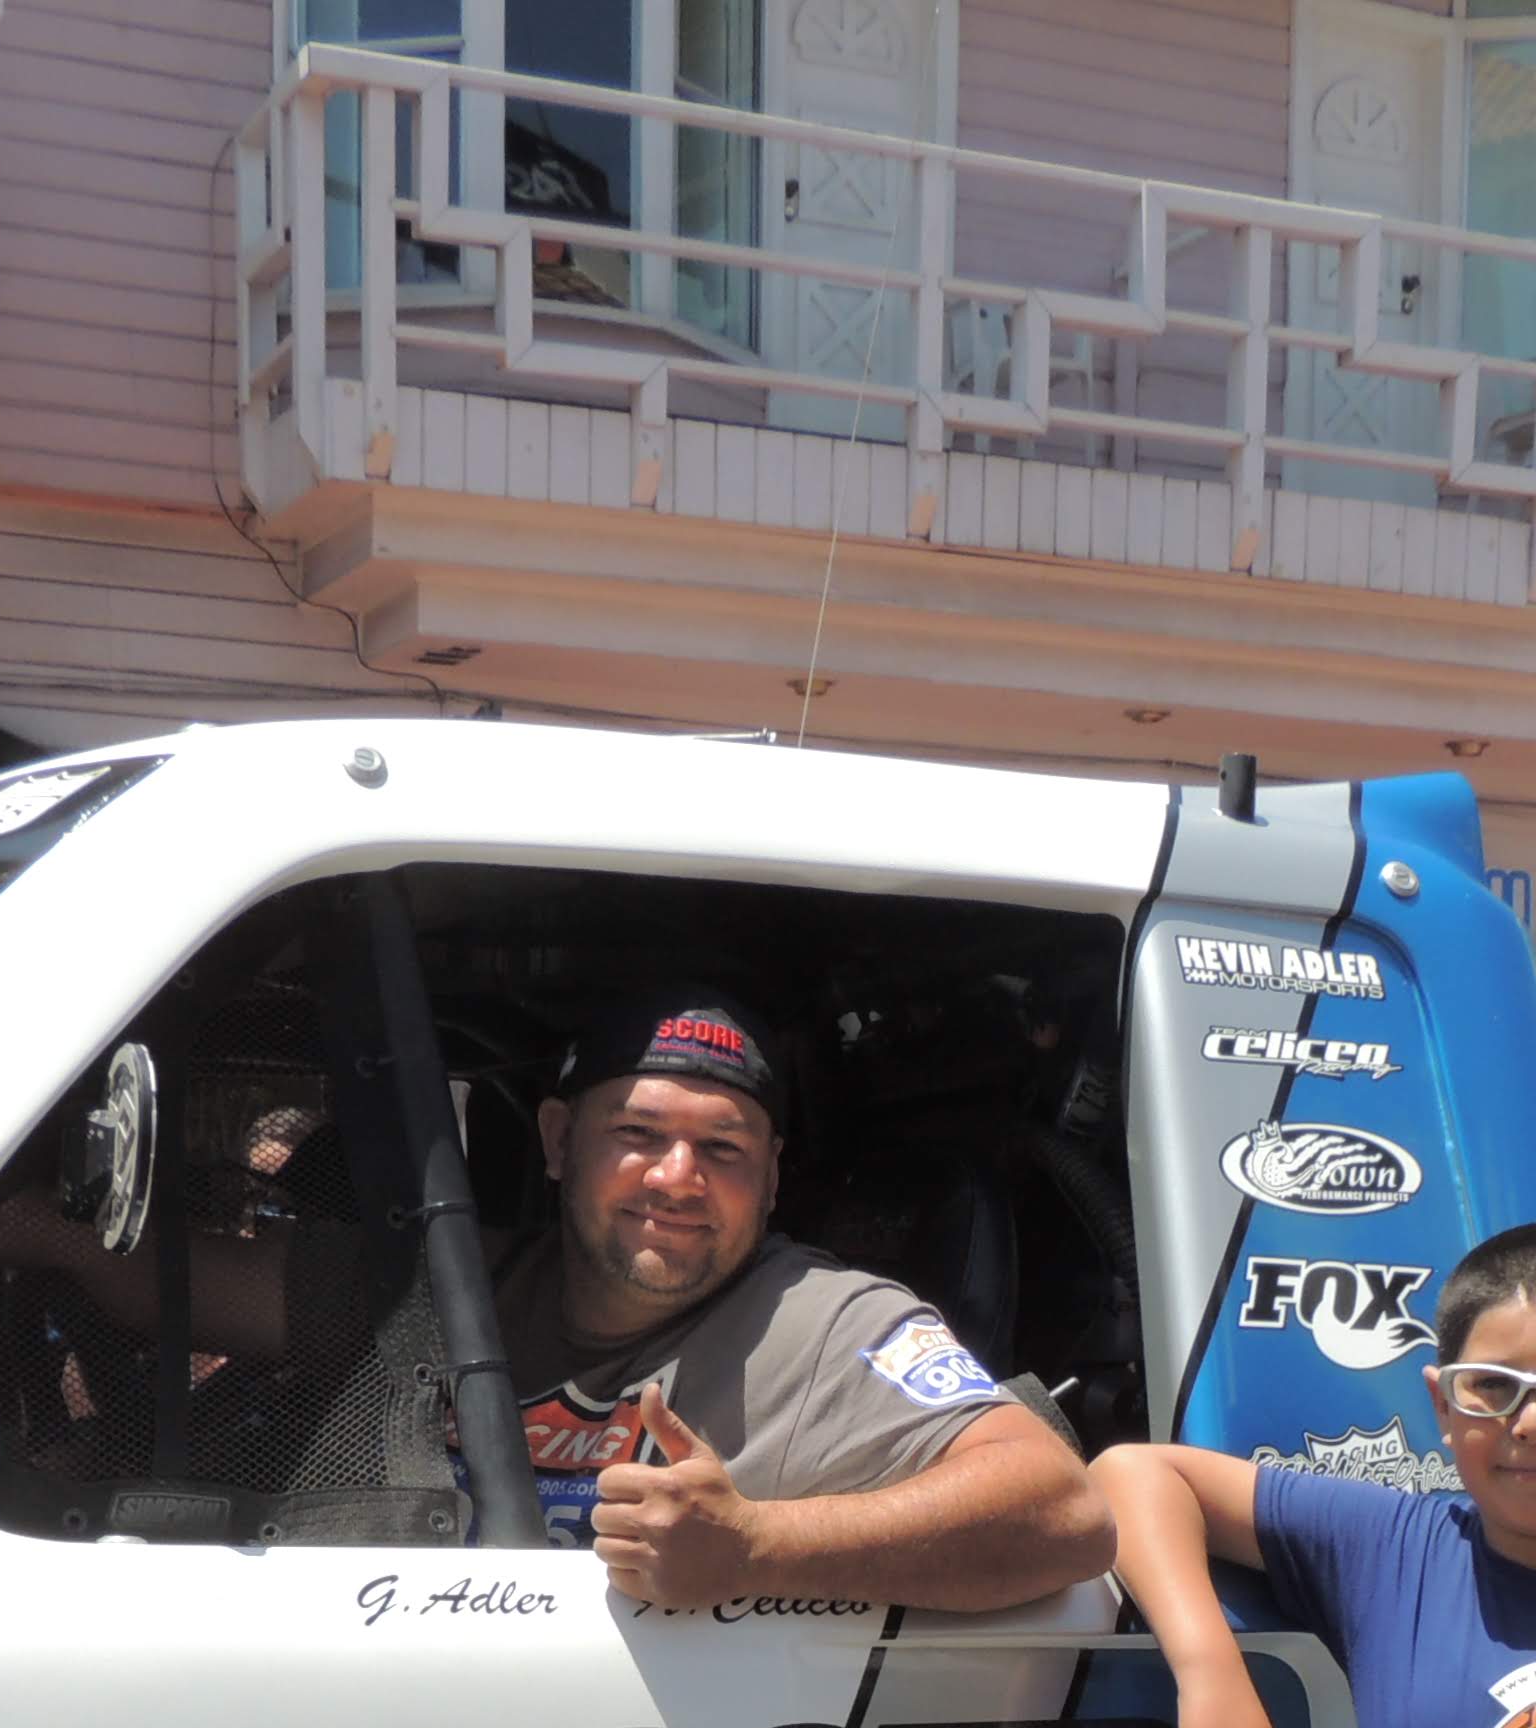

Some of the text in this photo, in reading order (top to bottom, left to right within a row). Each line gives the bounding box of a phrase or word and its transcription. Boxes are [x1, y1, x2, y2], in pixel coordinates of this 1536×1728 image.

[1177, 937, 1382, 986] KEVIN ADLER
[1219, 971, 1385, 1000] MOTORSPORTS
[655, 1018, 745, 1054] SCORE
[1211, 1026, 1267, 1037] TEAM
[1238, 1256, 1435, 1332] FOX
[355, 1573, 559, 1628] G. Adler
